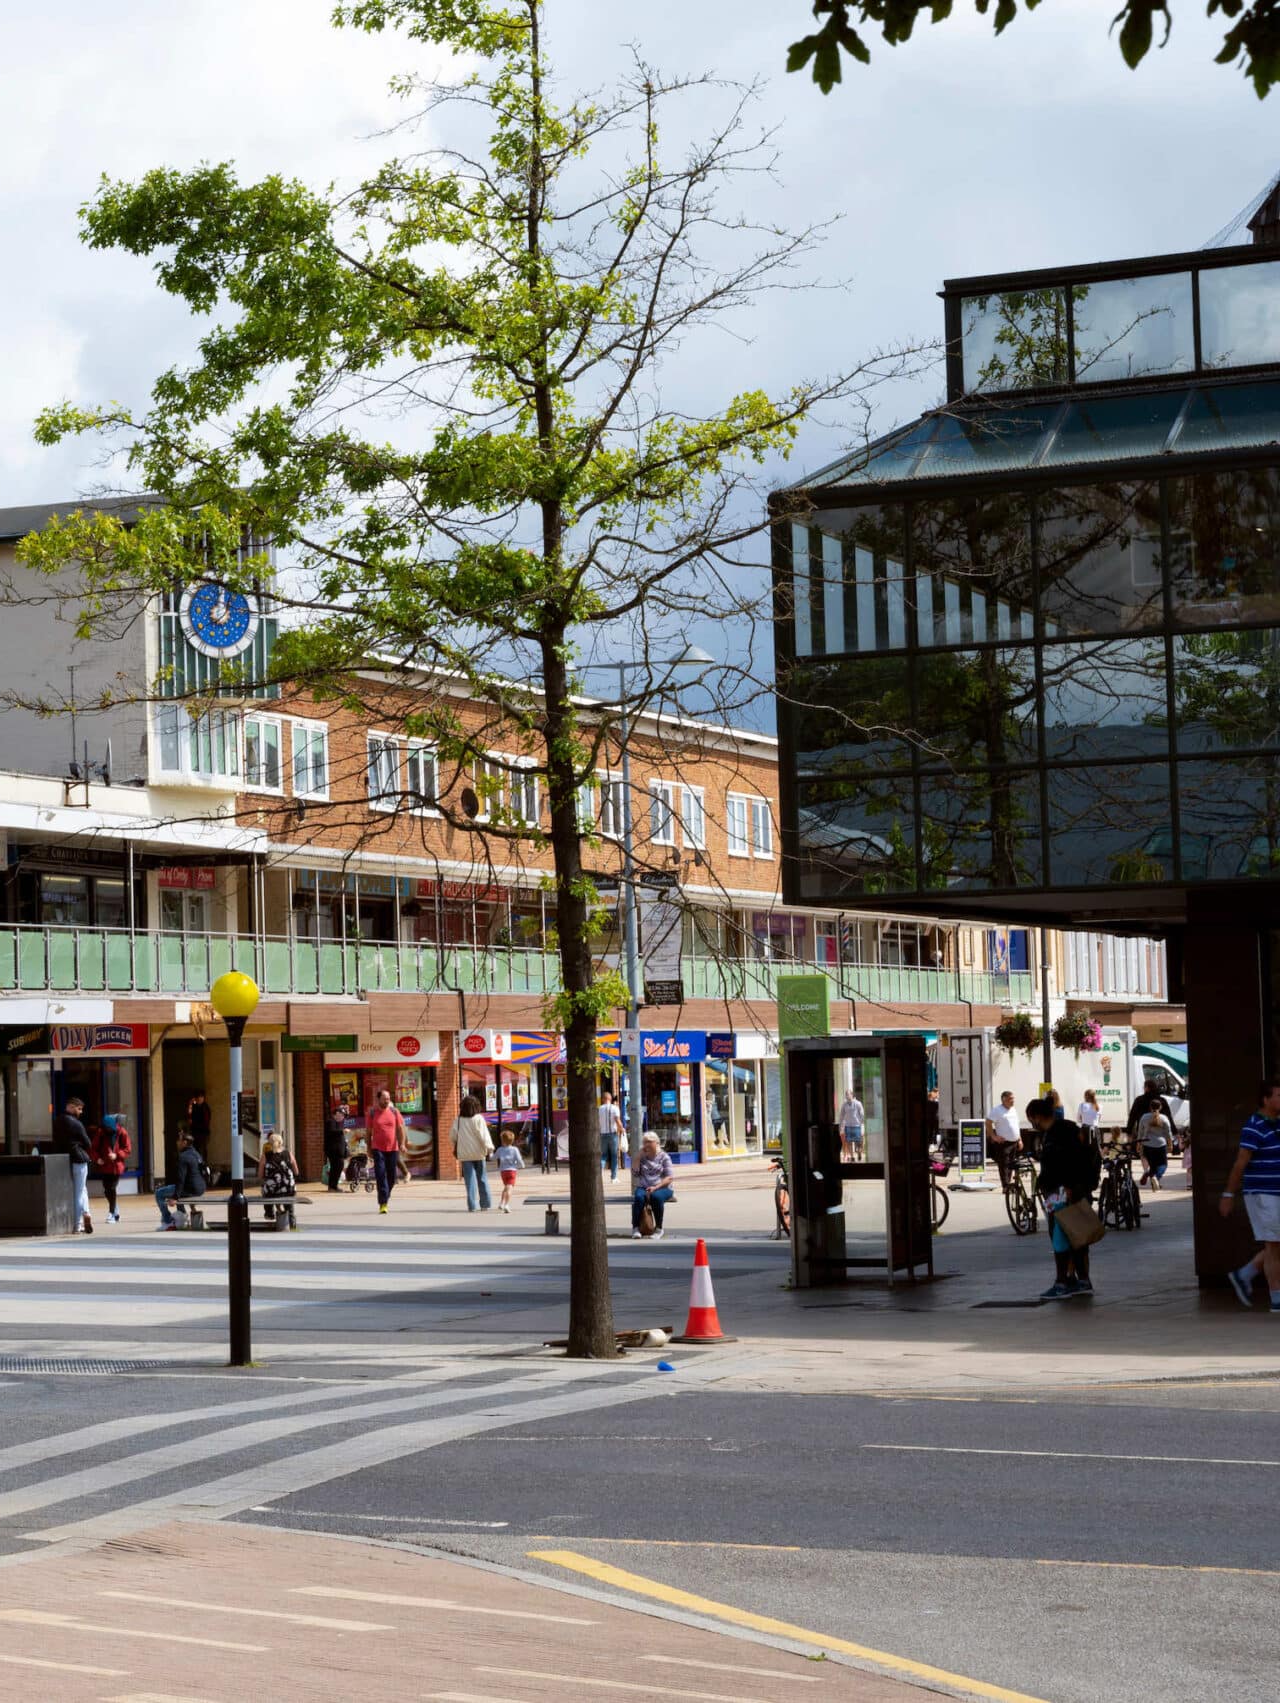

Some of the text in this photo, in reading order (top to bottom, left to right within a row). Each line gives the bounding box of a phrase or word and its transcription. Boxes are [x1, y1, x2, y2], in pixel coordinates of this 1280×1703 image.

[7, 1027, 44, 1051] SUBWAY
[95, 1029, 132, 1043] CHICKEN
[361, 1043, 383, 1052] Office
[644, 1038, 690, 1057] Shoe Zone
